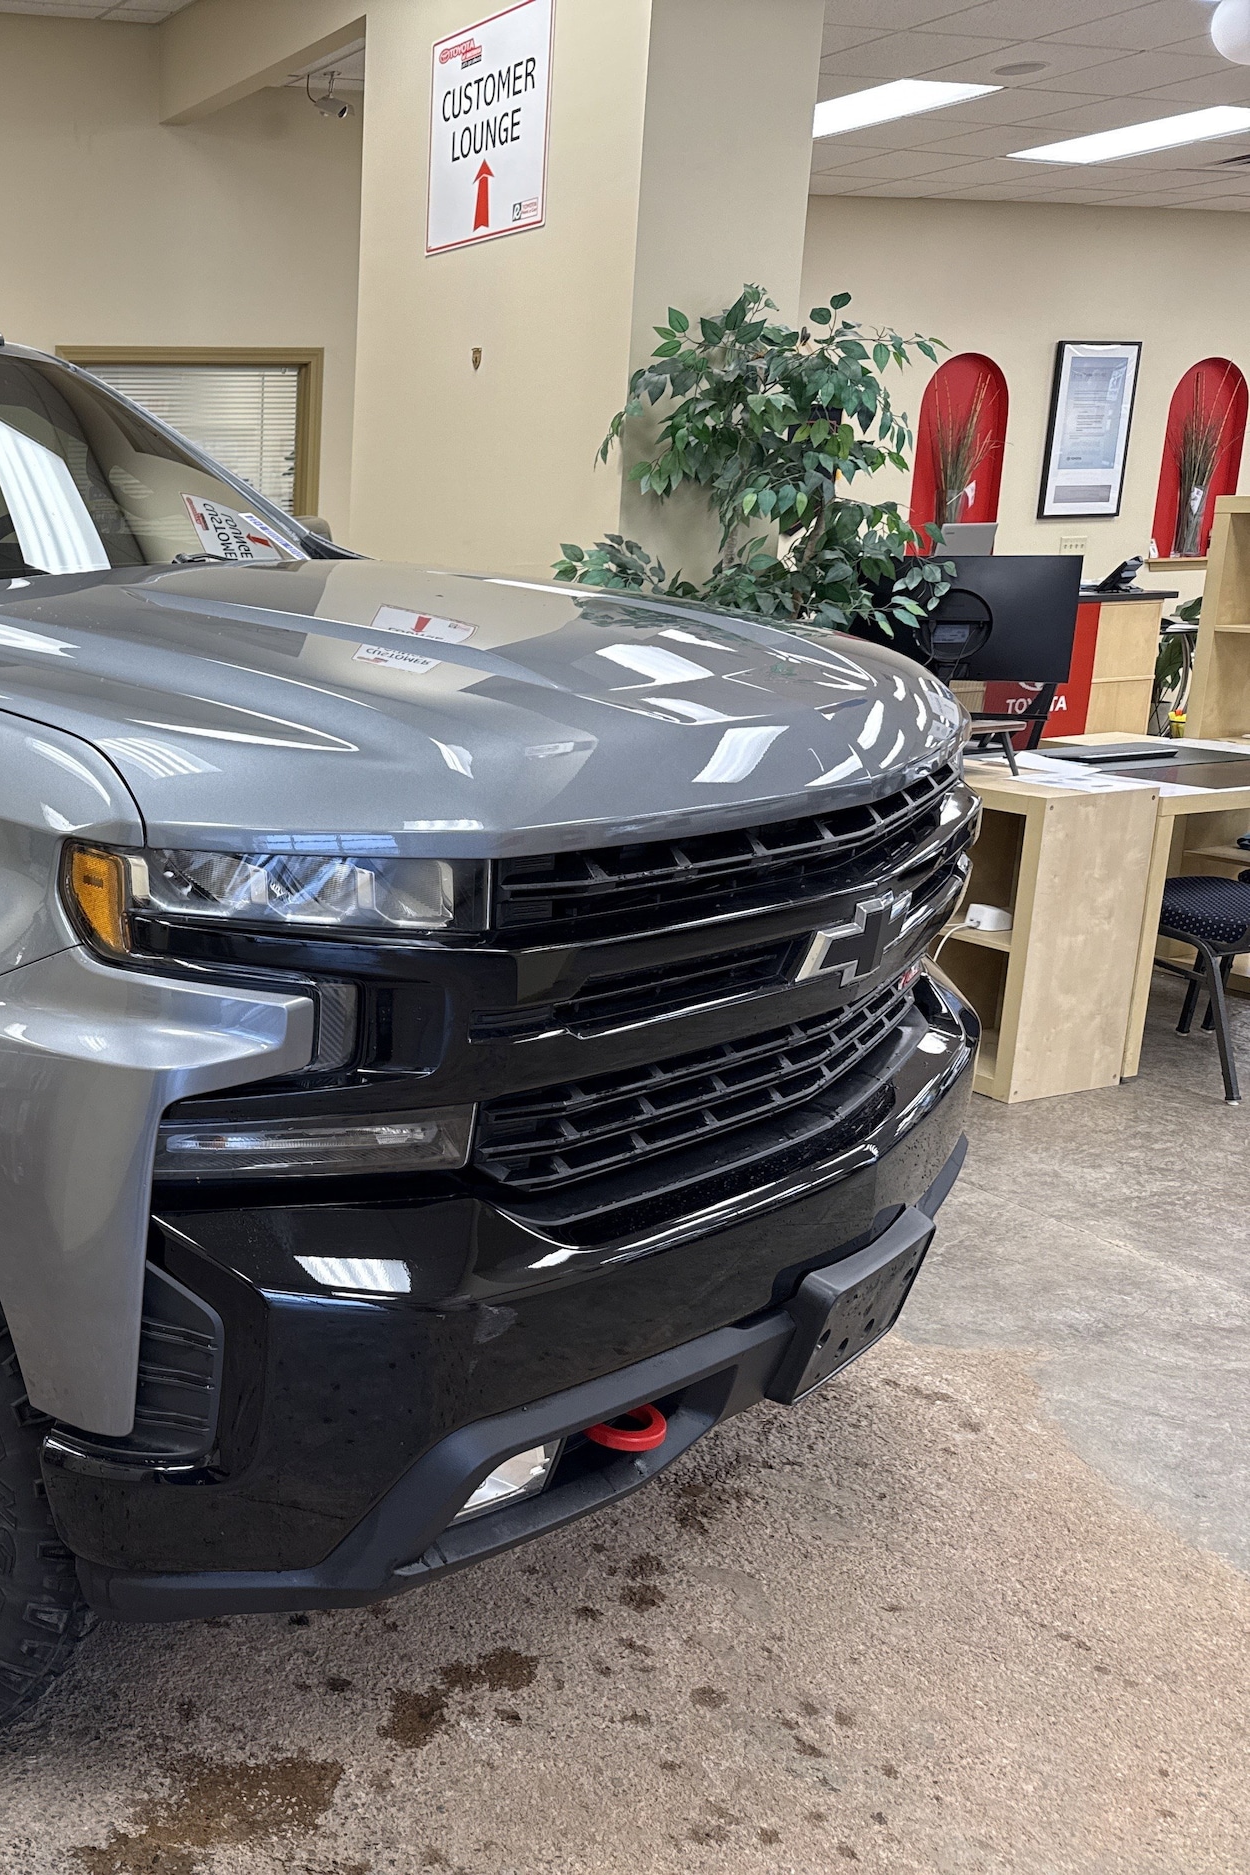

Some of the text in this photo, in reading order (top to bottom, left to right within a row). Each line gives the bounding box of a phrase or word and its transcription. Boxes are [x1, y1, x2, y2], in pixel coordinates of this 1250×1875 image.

[448, 39, 475, 60] TOYOTA
[442, 57, 537, 123] CUSTOMER
[451, 107, 522, 163] LOUNGE
[1006, 695, 1068, 714] TOTA
